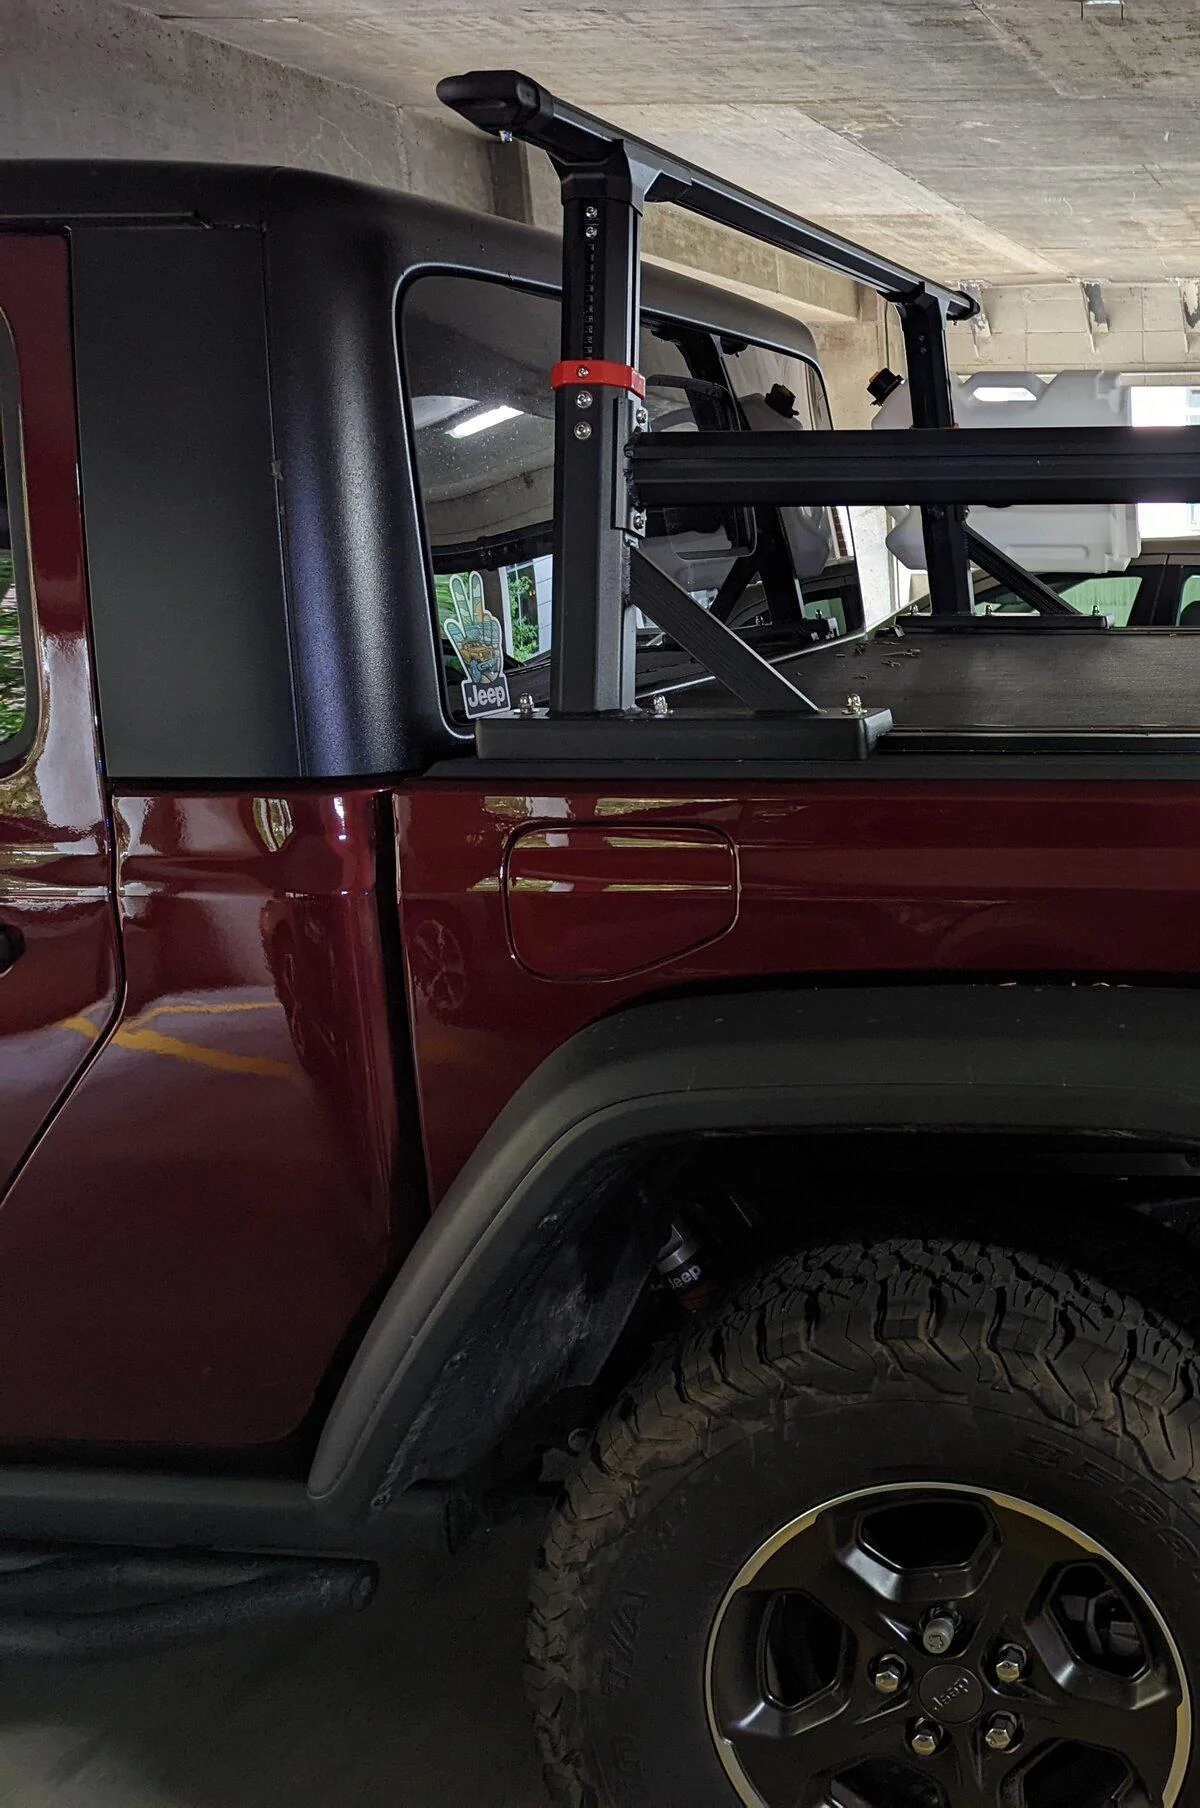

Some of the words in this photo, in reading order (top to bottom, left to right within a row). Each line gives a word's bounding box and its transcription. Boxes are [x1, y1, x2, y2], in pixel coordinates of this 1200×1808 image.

[468, 685, 506, 708] Jeep
[667, 1265, 702, 1290] Jeep
[932, 1676, 969, 1711] Jeep
